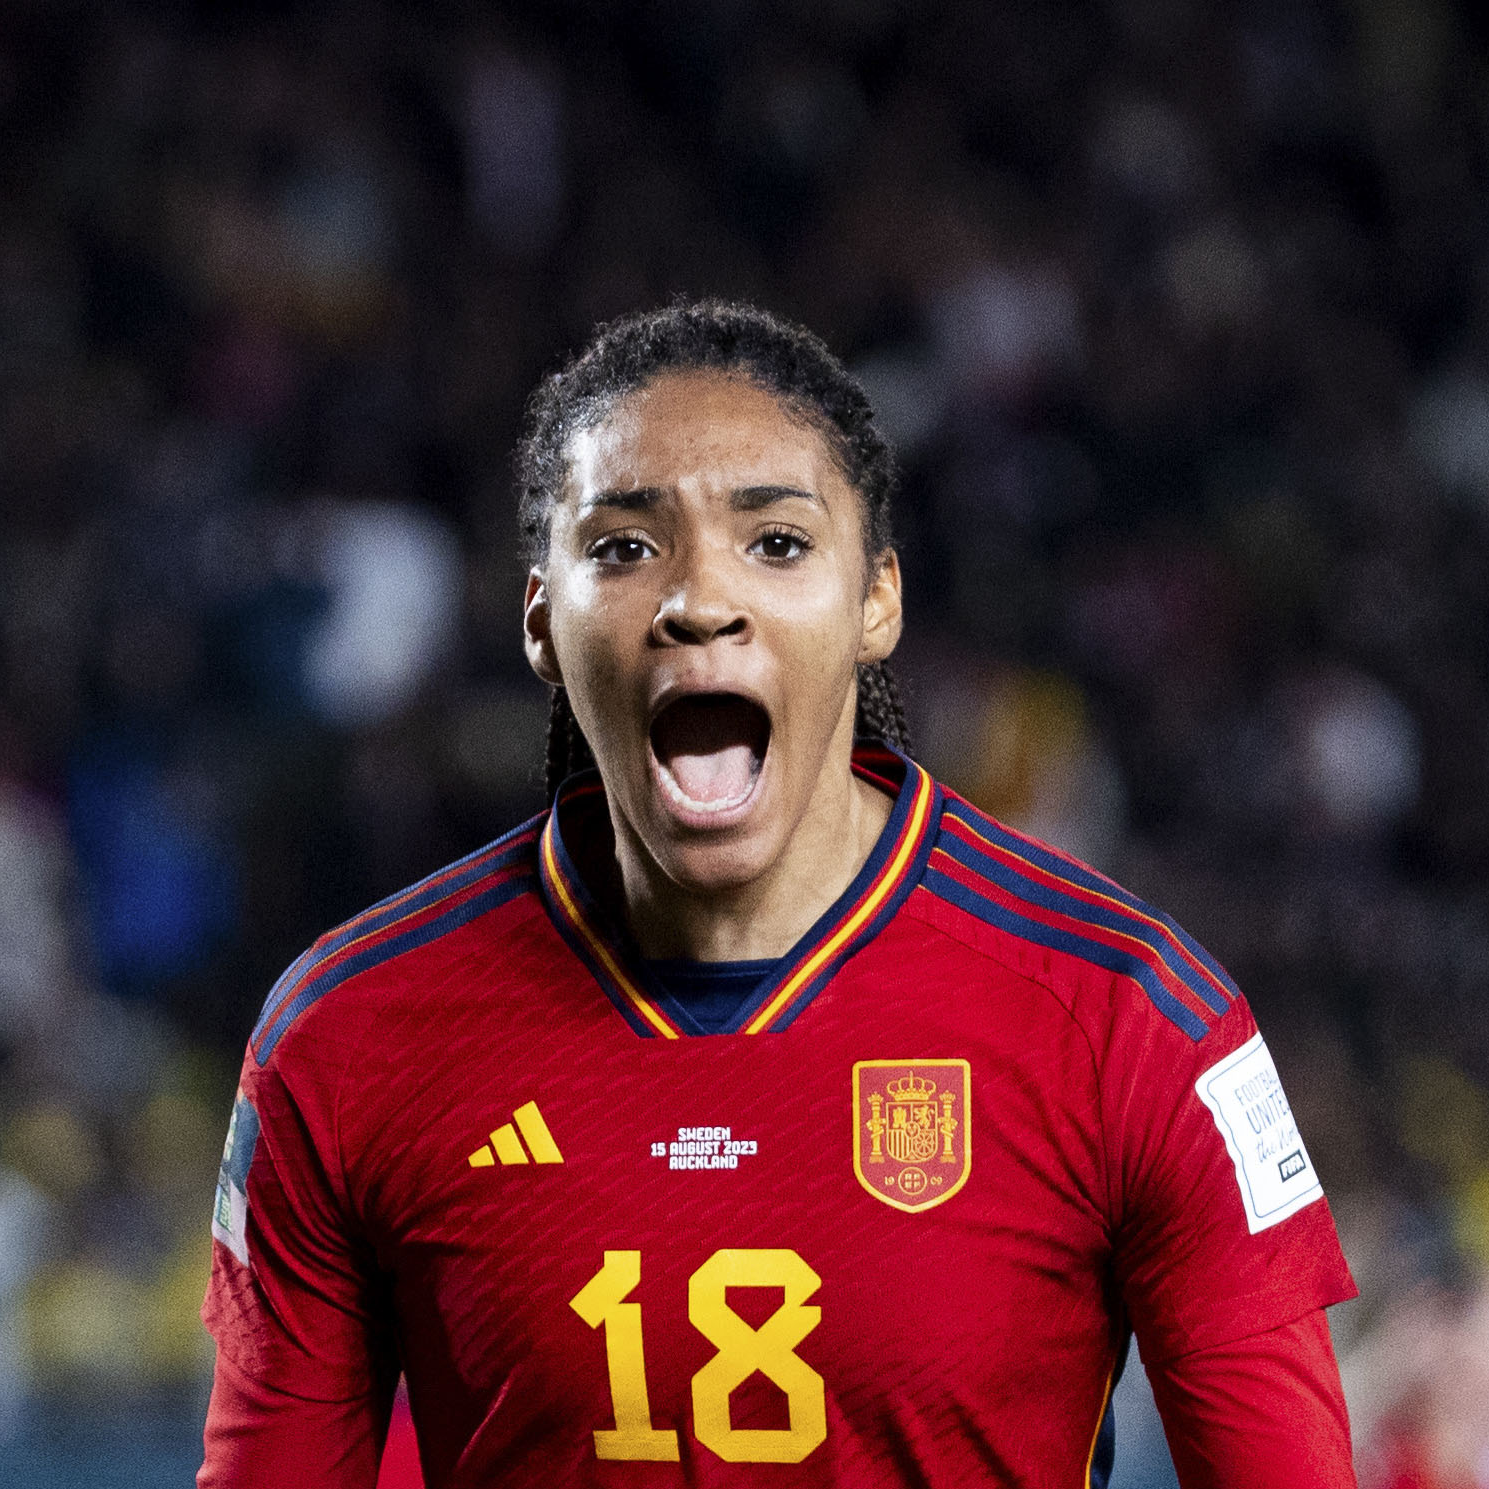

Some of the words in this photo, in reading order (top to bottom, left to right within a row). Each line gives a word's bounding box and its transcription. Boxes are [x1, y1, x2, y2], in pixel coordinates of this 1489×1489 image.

[677, 1127, 731, 1141] SWEDEN
[650, 1142, 666, 1157] 15
[669, 1141, 721, 1156] AUGUST
[723, 1140, 758, 1155] 2023
[669, 1155, 738, 1170] AUCKLAND
[569, 1248, 827, 1463] 18
